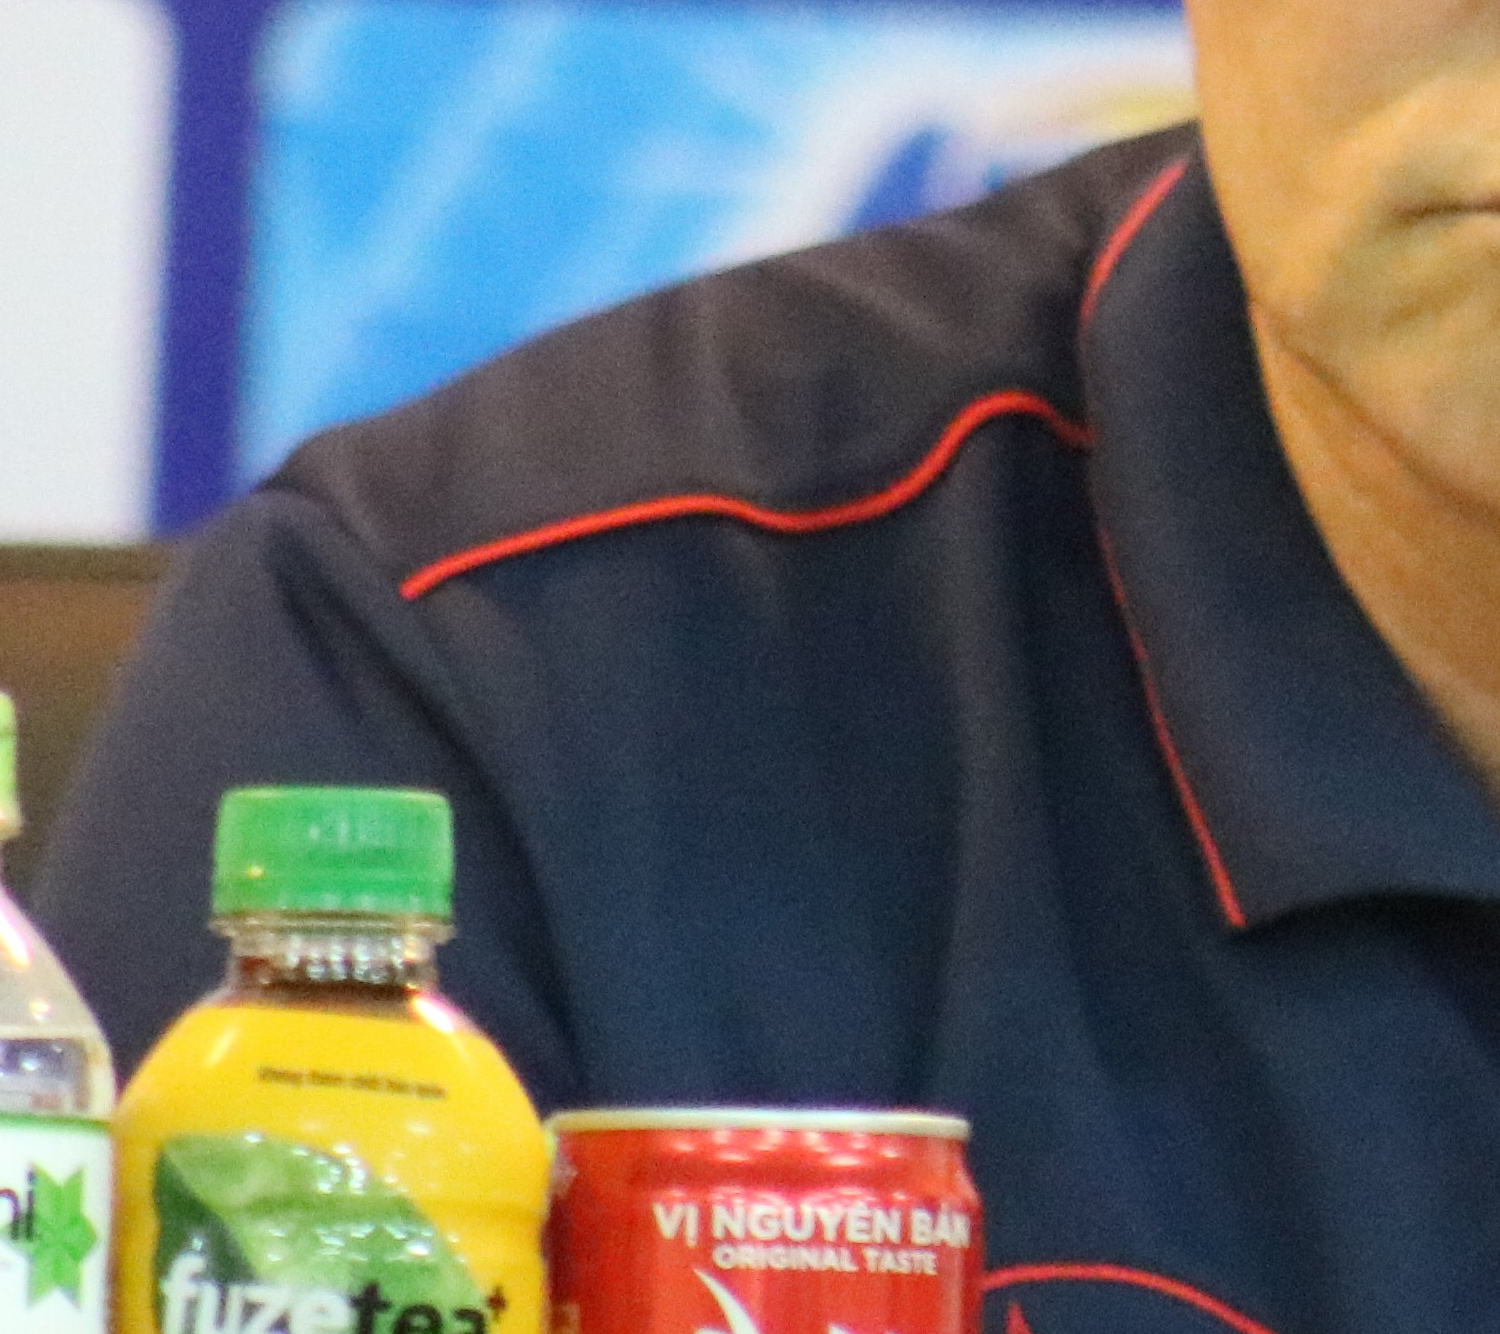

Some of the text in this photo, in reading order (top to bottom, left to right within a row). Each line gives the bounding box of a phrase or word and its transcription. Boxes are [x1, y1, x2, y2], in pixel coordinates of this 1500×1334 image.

[652, 1200, 698, 1249] VỊ
[711, 1242, 938, 1276] ORIGINAL TASTE
